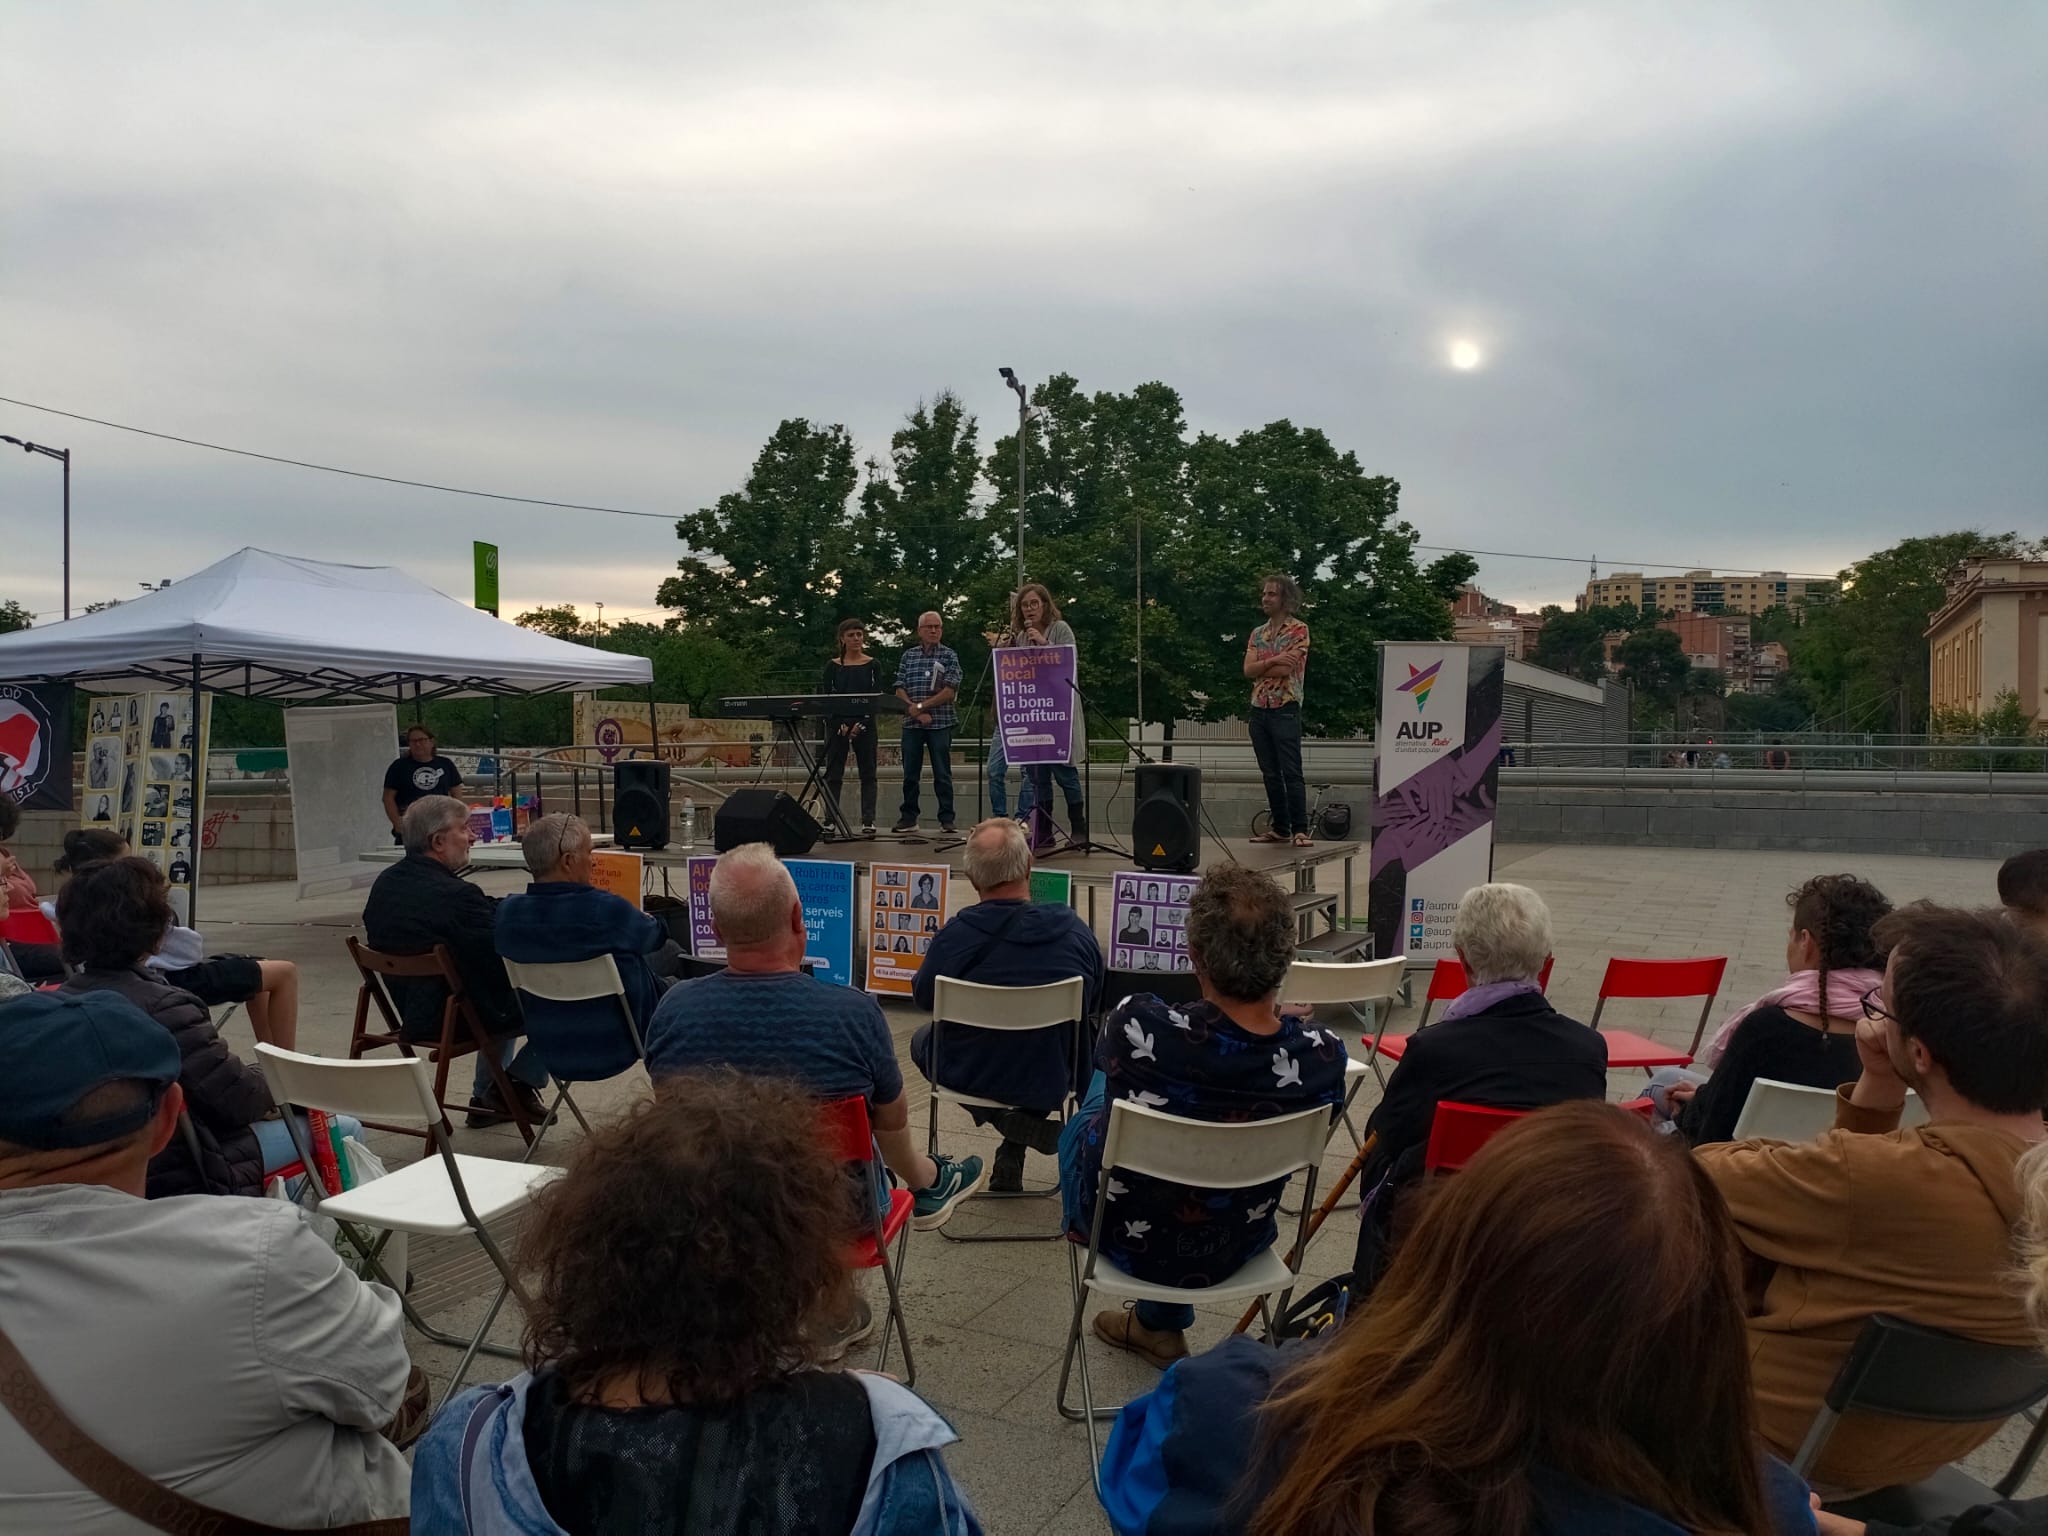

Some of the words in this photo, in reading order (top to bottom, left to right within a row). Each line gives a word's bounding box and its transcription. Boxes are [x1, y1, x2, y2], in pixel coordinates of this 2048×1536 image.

[1001, 654, 1016, 667] Al
[1020, 652, 1062, 668] partit
[1001, 667, 1036, 681] local
[1002, 682, 1016, 695] hi
[1019, 681, 1036, 694] ha
[1003, 697, 1016, 710] la
[1019, 696, 1054, 709] bona
[1395, 721, 1443, 740] AUP
[693, 893, 706, 906] hi
[1425, 900, 1458, 911] /aupru
[695, 907, 706, 920] la
[805, 907, 844, 919] serveis
[1425, 914, 1456, 925] @aupr
[804, 919, 825, 930] alut
[1424, 927, 1452, 937] @aup
[1423, 940, 1452, 950] aupru
